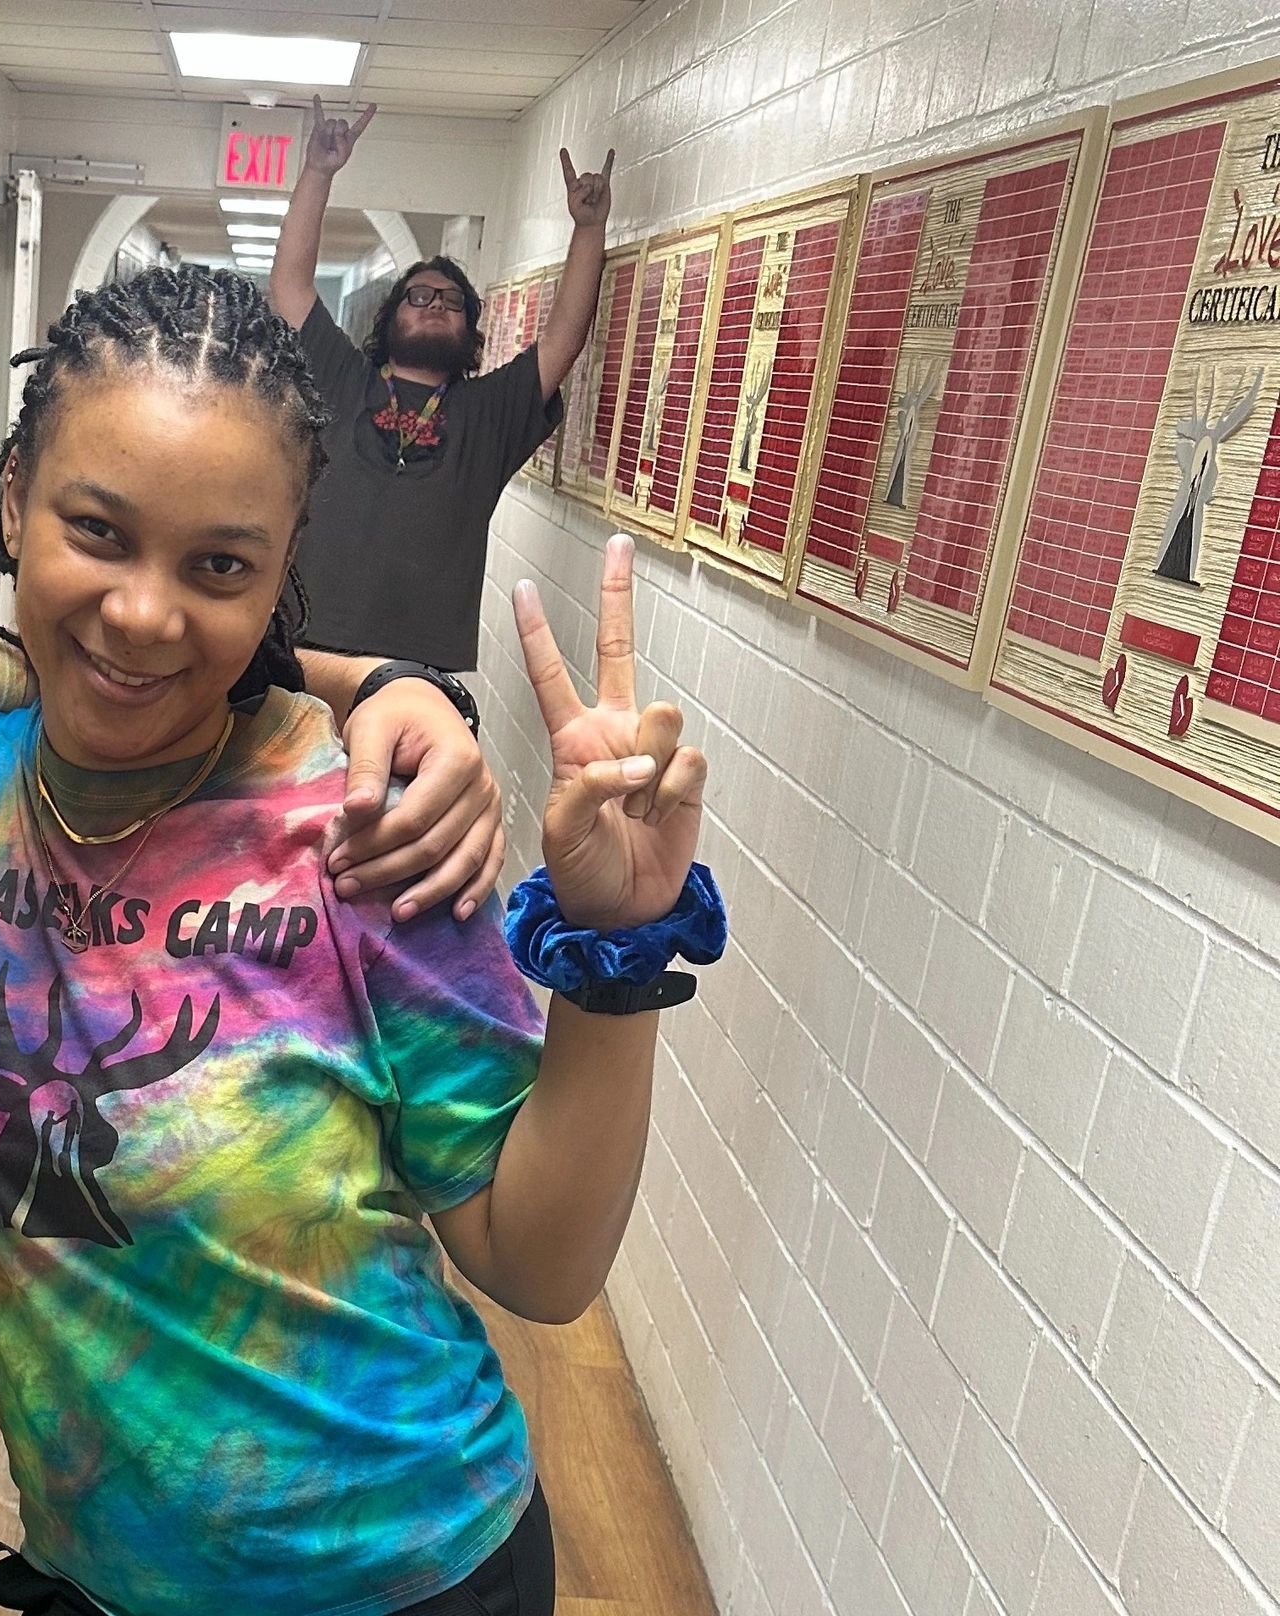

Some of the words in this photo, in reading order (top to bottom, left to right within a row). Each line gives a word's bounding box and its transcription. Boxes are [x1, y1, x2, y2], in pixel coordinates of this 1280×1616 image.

[226, 131, 293, 186] EXIT
[943, 198, 963, 224] THE
[919, 250, 956, 295] Love
[1188, 285, 1280, 323] CERTIFICA
[40, 880, 152, 948] ELKS
[165, 900, 319, 970] CAMP
